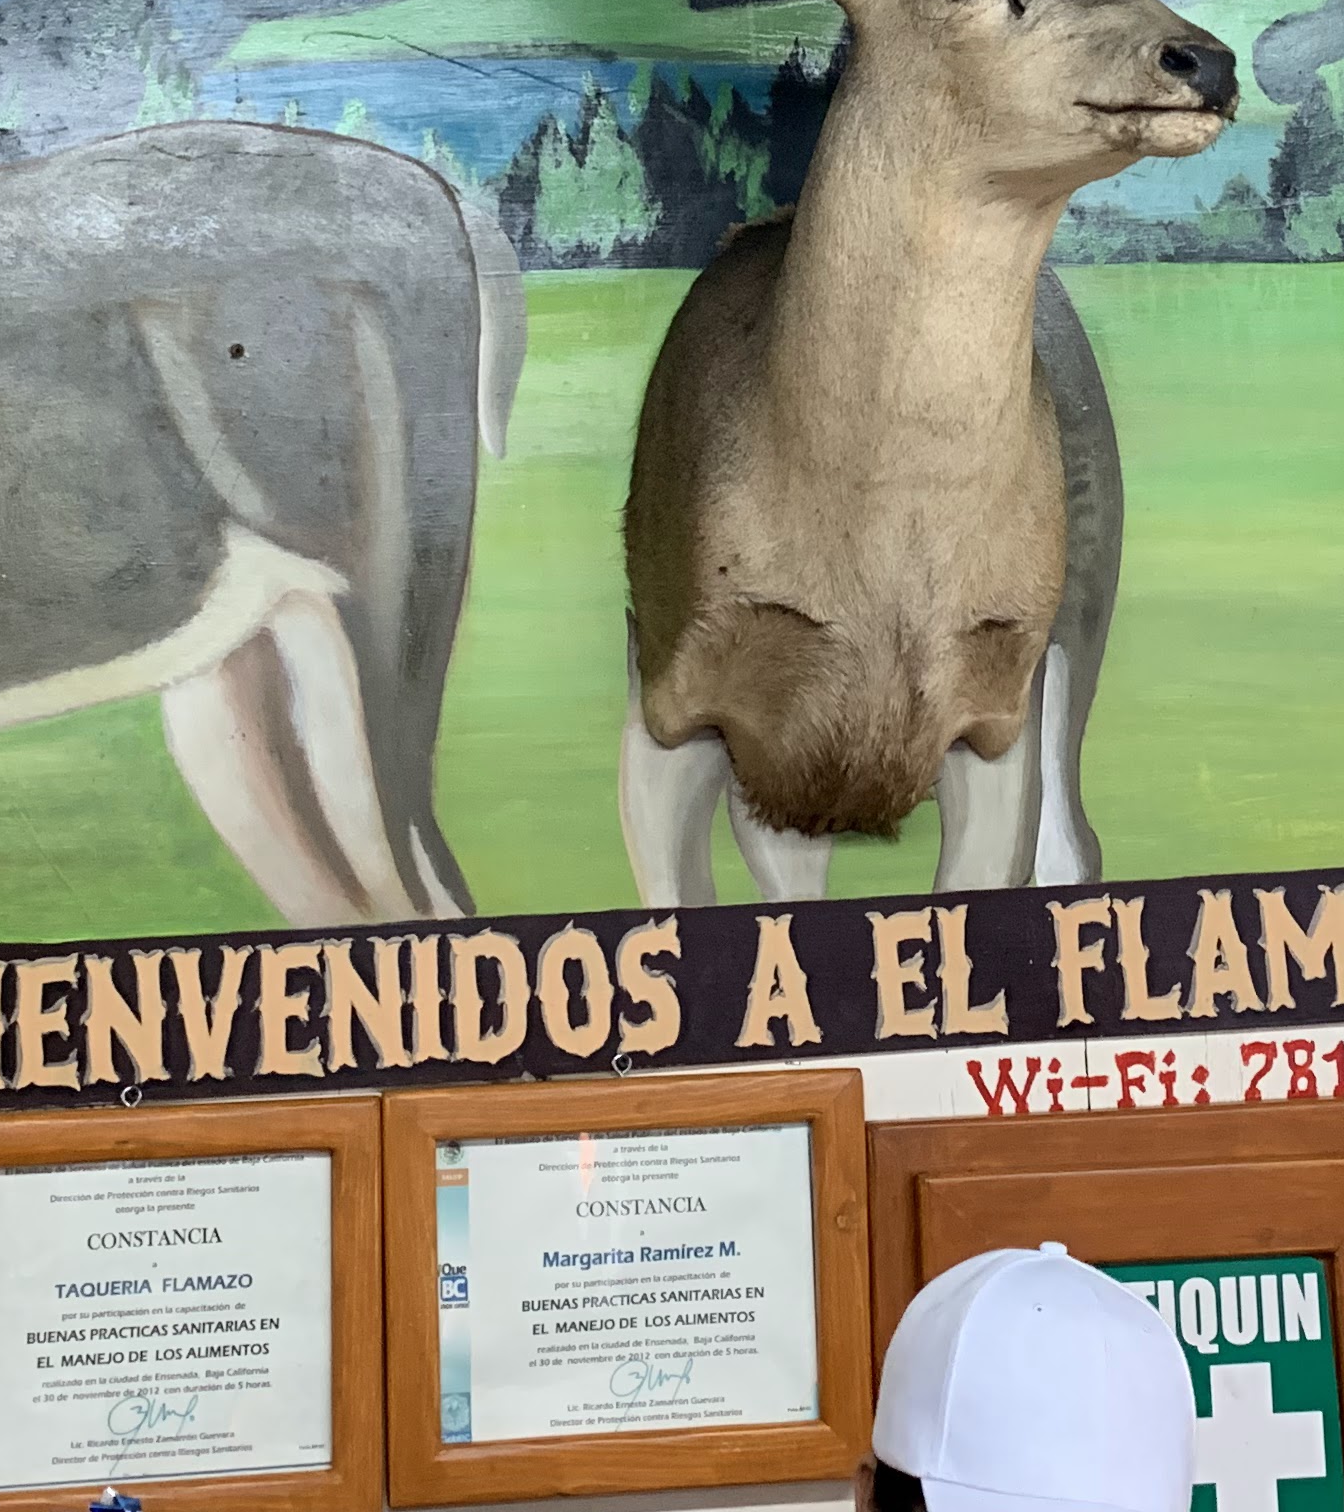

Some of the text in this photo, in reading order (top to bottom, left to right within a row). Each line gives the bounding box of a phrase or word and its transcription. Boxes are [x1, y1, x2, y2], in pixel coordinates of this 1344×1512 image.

[736, 913, 825, 1048] A
[865, 900, 1009, 1040] EL
[967, 1050, 1211, 1116] Wi-Fi:
[575, 1195, 708, 1218] CONSTANCIA
[87, 1227, 223, 1251] CONSTANCIA
[543, 1241, 741, 1270] Margarita Ramírez M.
[55, 1273, 253, 1299] TAQUERIA FLAMAZO
[442, 1279, 466, 1299] BC
[554, 1281, 570, 1291] por
[640, 1276, 652, 1285] en
[652, 1274, 662, 1283] la
[719, 1270, 731, 1279] de
[61, 1312, 77, 1322] por
[152, 1307, 163, 1316] en
[164, 1306, 173, 1314] la
[234, 1301, 246, 1311] de
[522, 1286, 765, 1313] BUENAS PRACTICAS SANITARIAS EN
[26, 1317, 280, 1345] BUENAS PRACTICAS SANITARIAS EN
[532, 1310, 756, 1336] EL MANEJO DE LOS ALIMENTOS
[714, 1333, 756, 1344] California
[37, 1343, 270, 1369] EL MANEJO DE LOS ALIMENTOS
